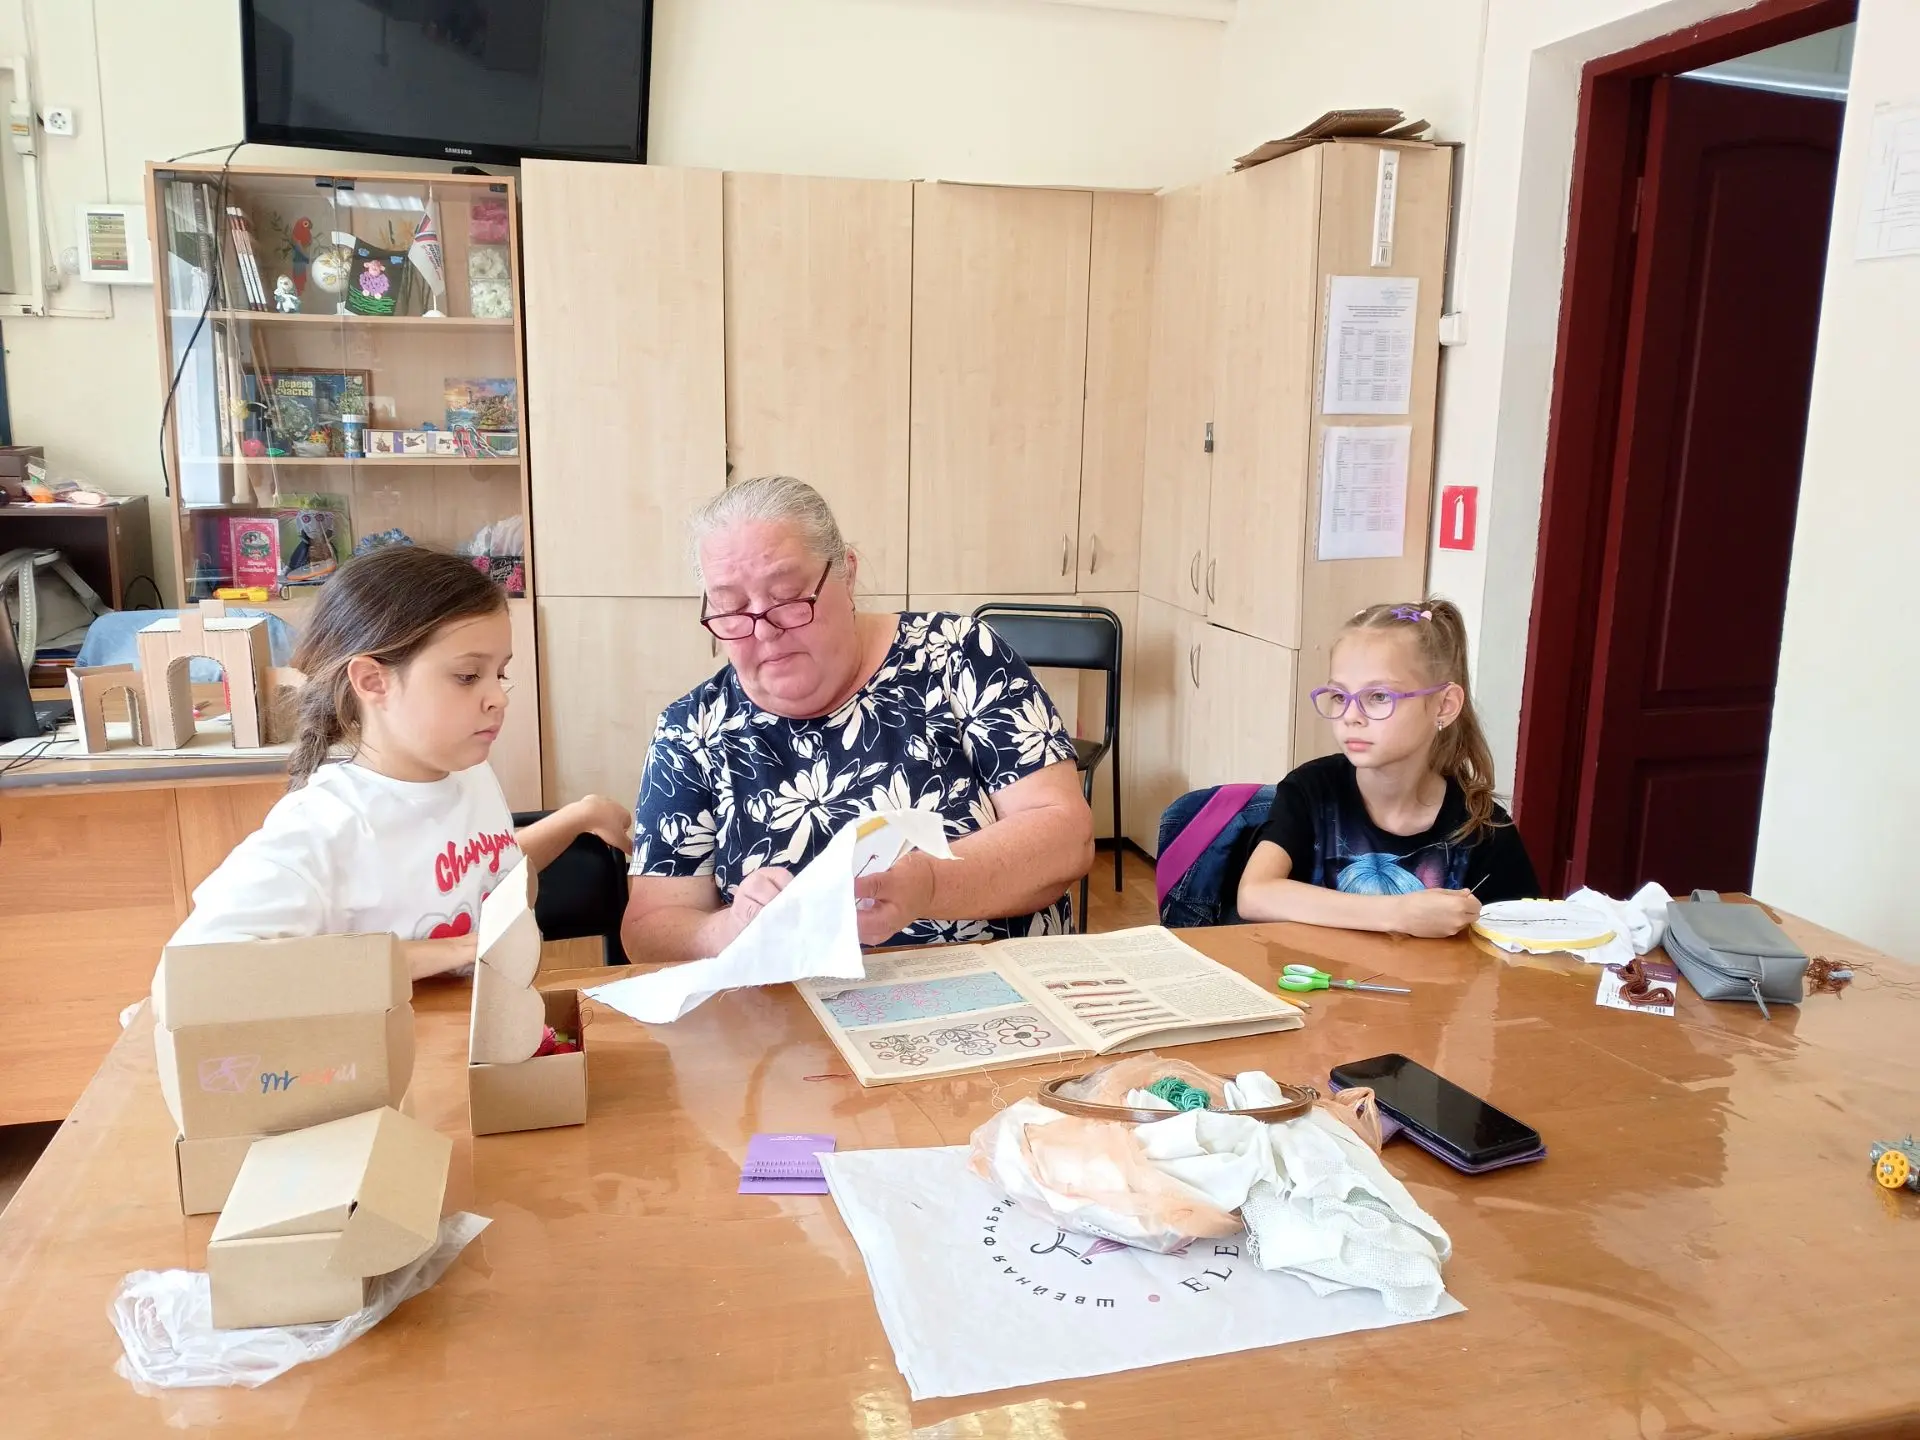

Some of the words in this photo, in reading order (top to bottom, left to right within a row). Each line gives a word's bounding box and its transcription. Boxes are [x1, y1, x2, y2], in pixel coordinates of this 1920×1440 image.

[444, 147, 472, 155] SAMSUNG
[278, 379, 313, 389] Дерево
[275, 387, 313, 397] счастья
[992, 1255, 1115, 1308] ШВЕЙНАЯ
